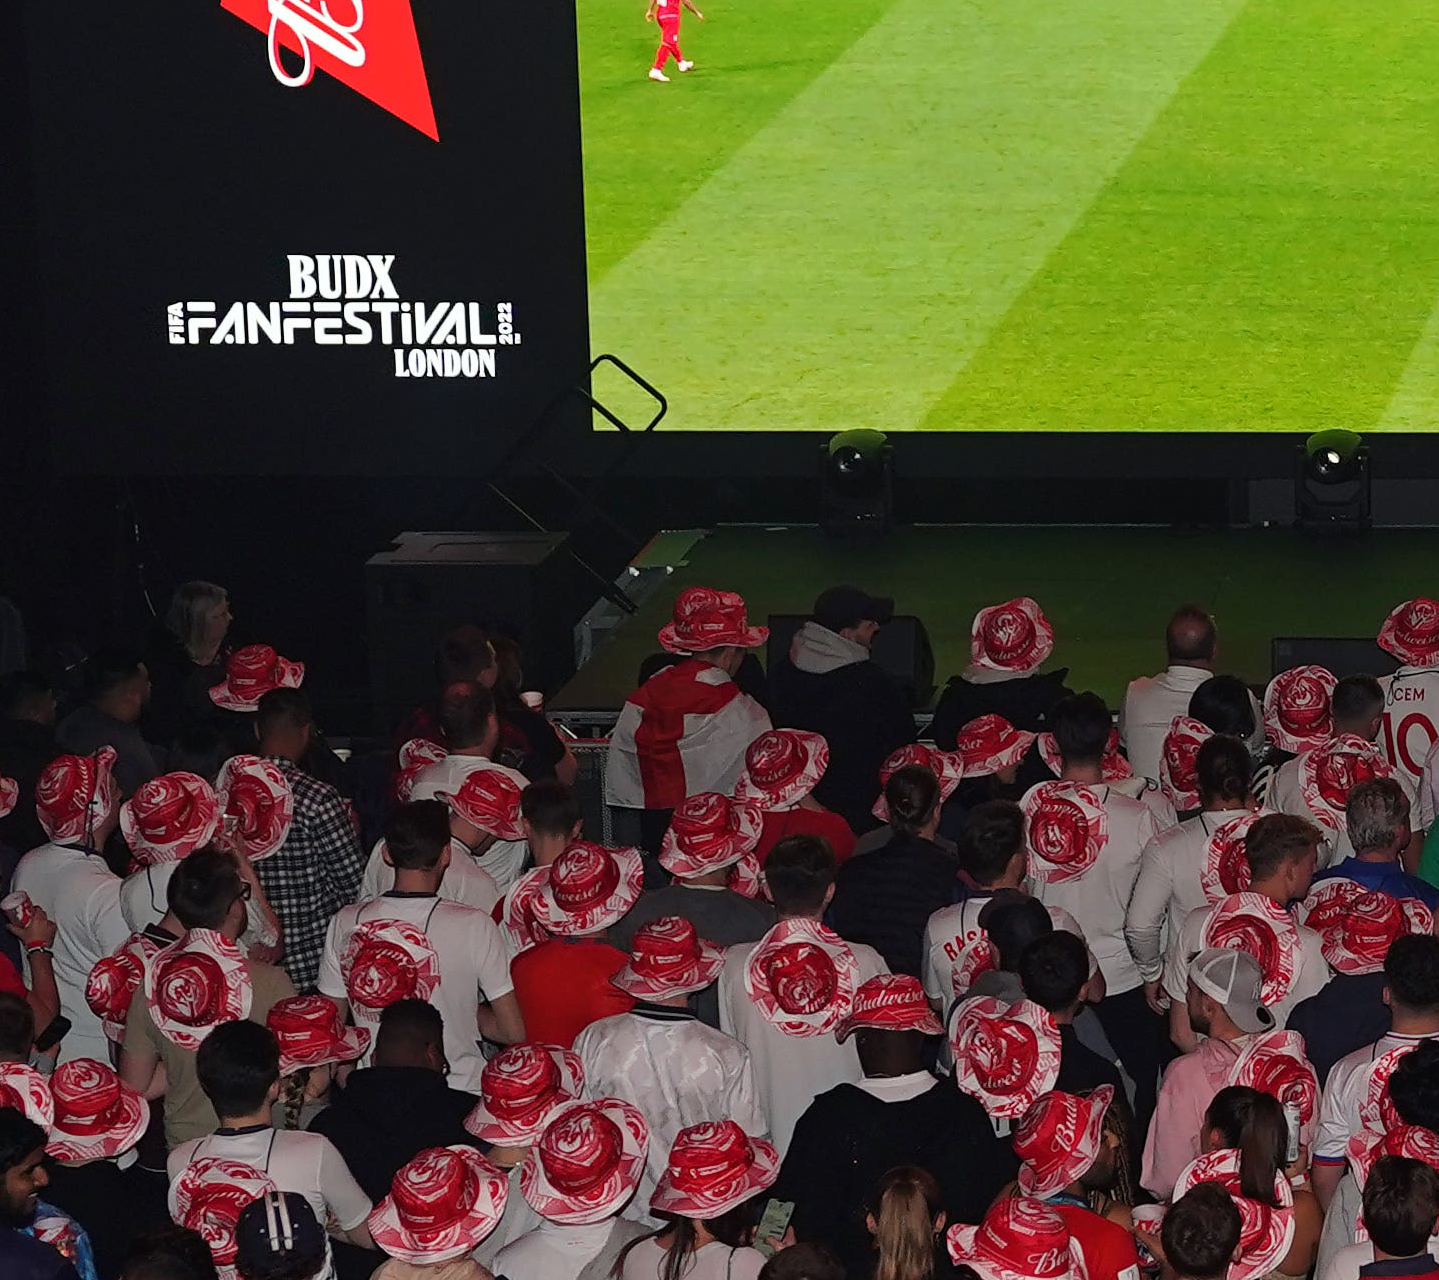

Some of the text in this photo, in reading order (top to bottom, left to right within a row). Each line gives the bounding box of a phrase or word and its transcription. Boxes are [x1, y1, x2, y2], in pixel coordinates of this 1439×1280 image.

[287, 254, 399, 299] BUDX
[167, 301, 185, 345] FIFA
[498, 302, 513, 345] 2022
[393, 348, 496, 378] LONDON
[1393, 688, 1426, 701] CEM
